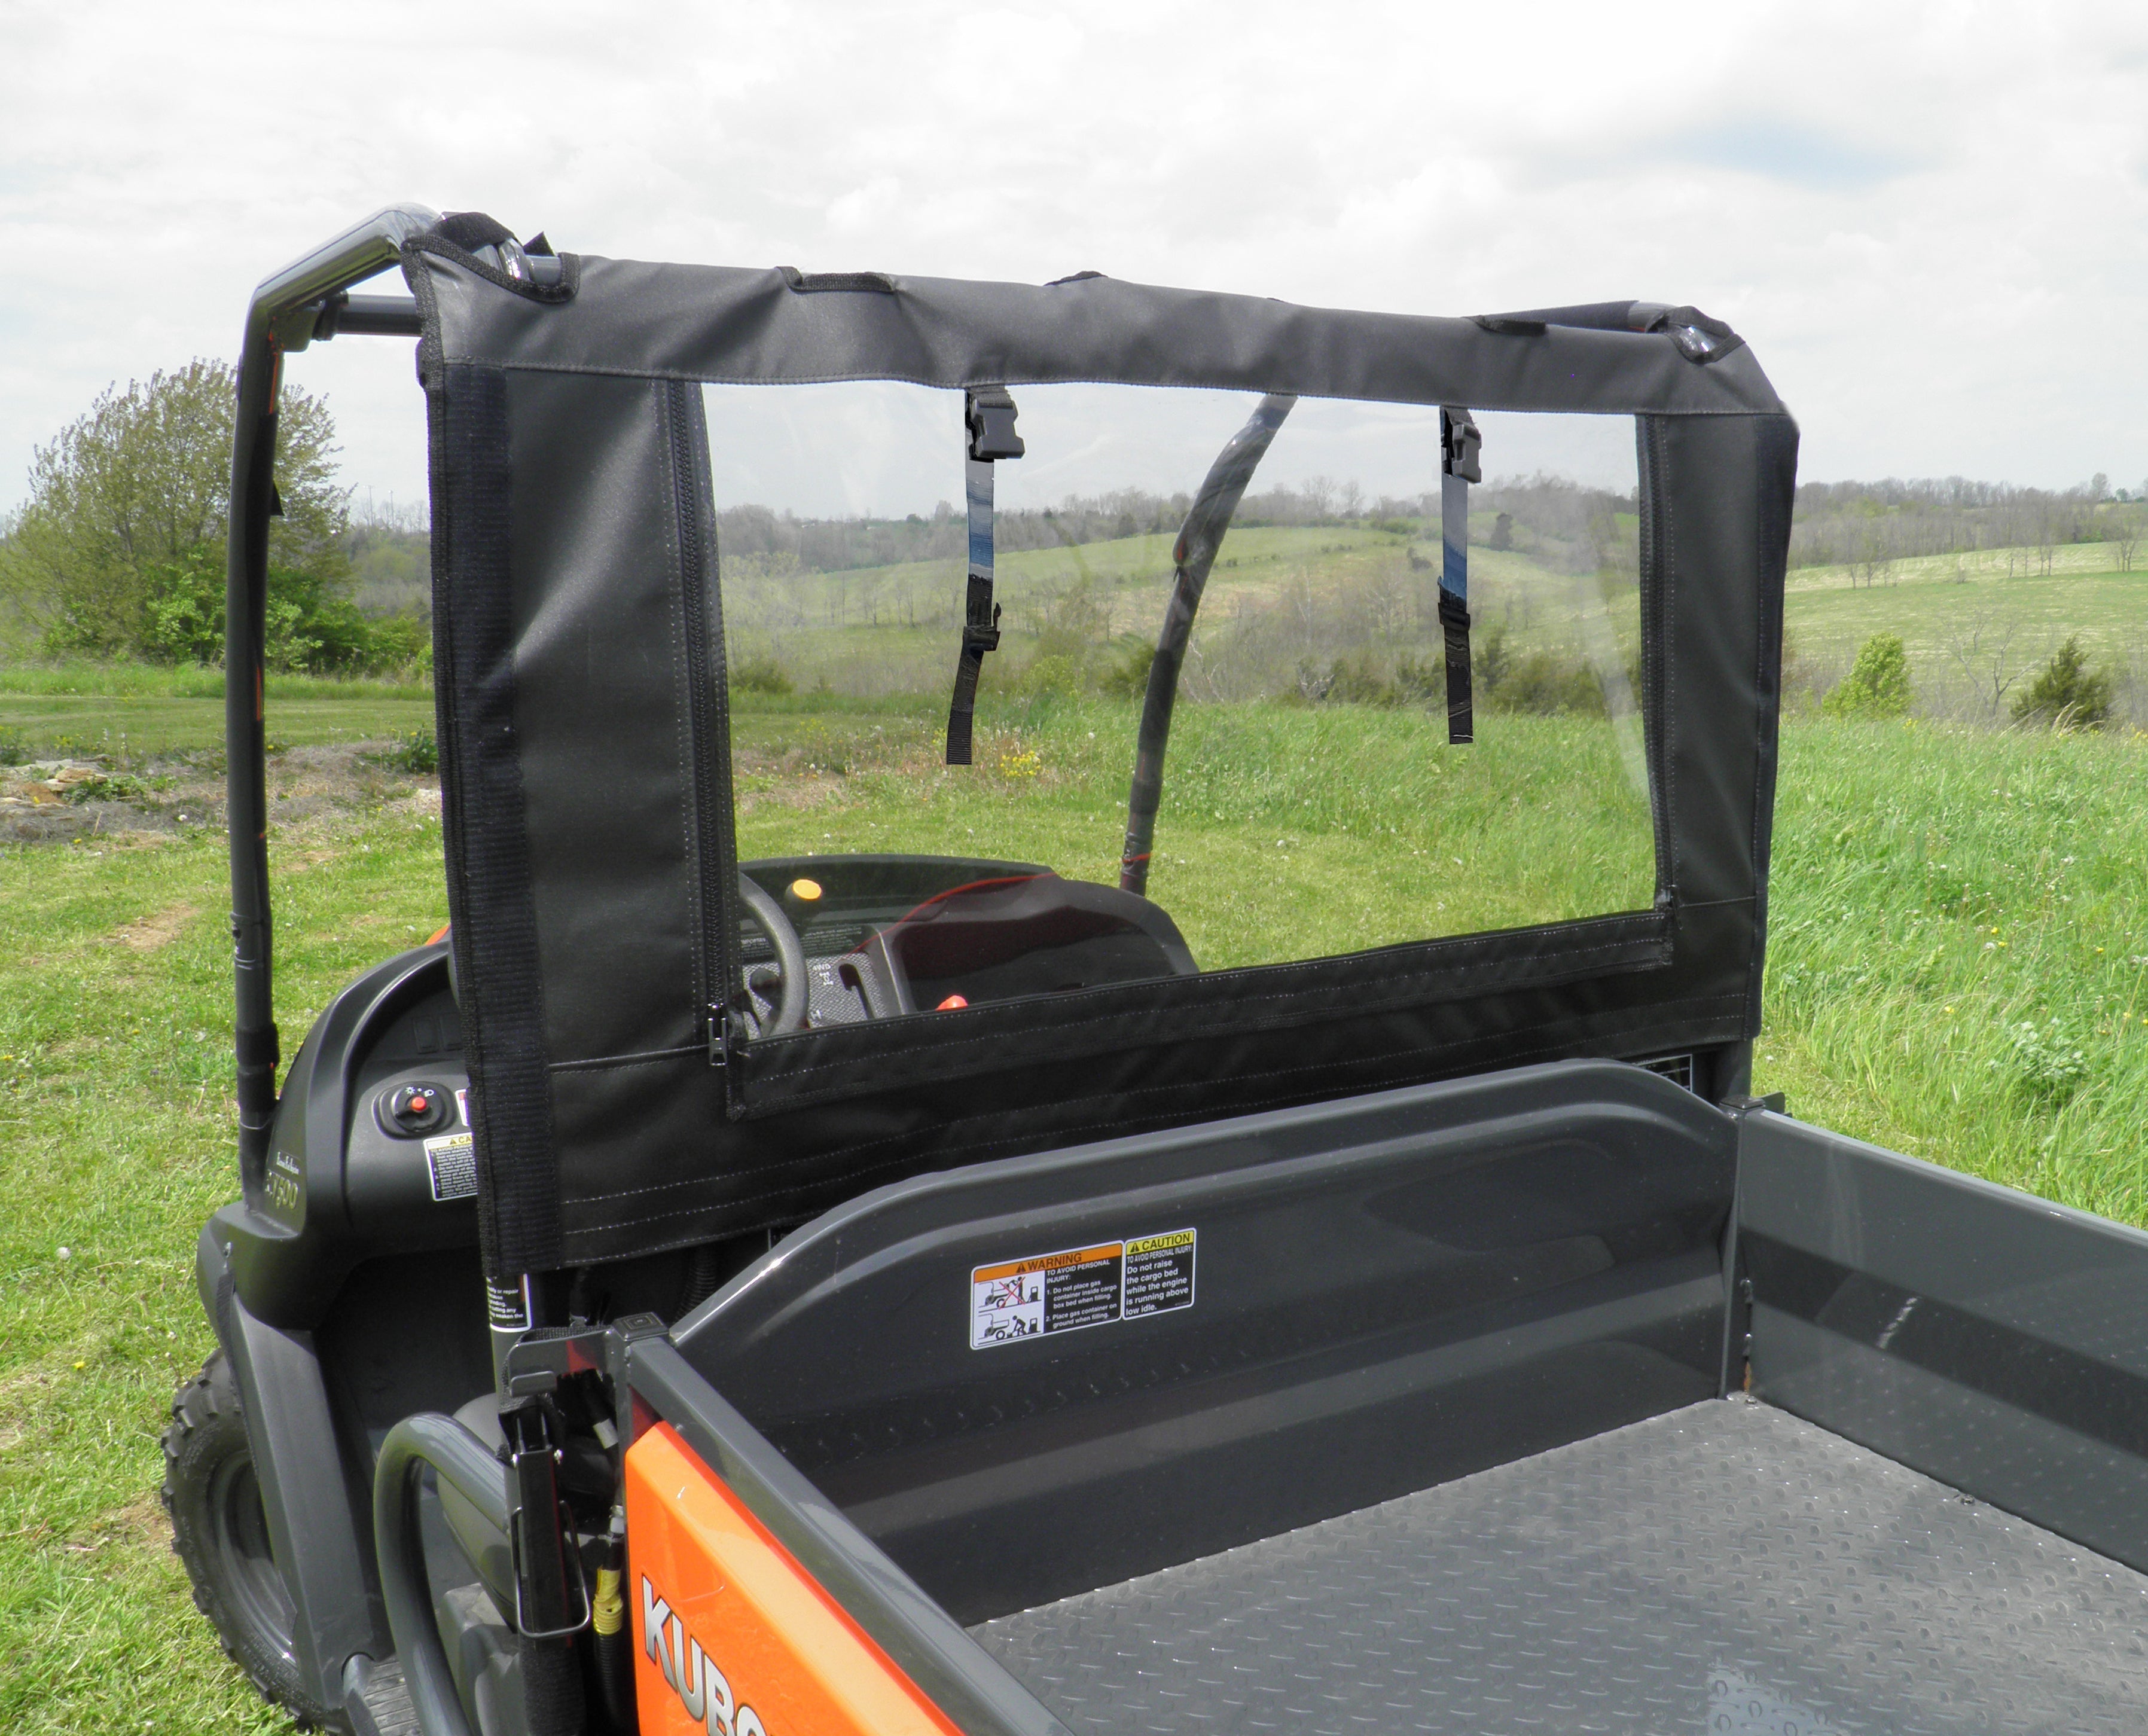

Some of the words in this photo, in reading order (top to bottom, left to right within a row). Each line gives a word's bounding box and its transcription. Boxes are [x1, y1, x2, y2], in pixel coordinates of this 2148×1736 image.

[812, 963, 831, 971] 4WD
[1142, 1233, 1190, 1250] CAUTION
[1028, 1253, 1082, 1271] WARNING
[1134, 1253, 1149, 1262] AVOID
[1150, 1248, 1174, 1259] PERSONAL
[1057, 1265, 1076, 1274] AVOID
[1077, 1259, 1110, 1271] PERSONAL
[1127, 1266, 1137, 1274] Do
[1140, 1264, 1152, 1272] not
[1154, 1259, 1173, 1269] raise
[1046, 1274, 1070, 1284] INJURY:
[1140, 1273, 1163, 1282] cargo
[1164, 1268, 1178, 1277] bed
[1073, 1282, 1089, 1290] place
[1127, 1285, 1146, 1295] while
[1162, 1277, 1188, 1288] engine
[1054, 1291, 1081, 1302] container
[1082, 1287, 1099, 1296] inside
[1100, 1285, 1117, 1293] cargo
[1078, 1296, 1093, 1305] when
[1135, 1292, 1164, 1303] running
[1166, 1287, 1189, 1297] above
[1070, 1310, 1080, 1318] gas
[1081, 1305, 1107, 1314] container
[1142, 1304, 1157, 1313] idle.
[1053, 1319, 1073, 1329] ground
